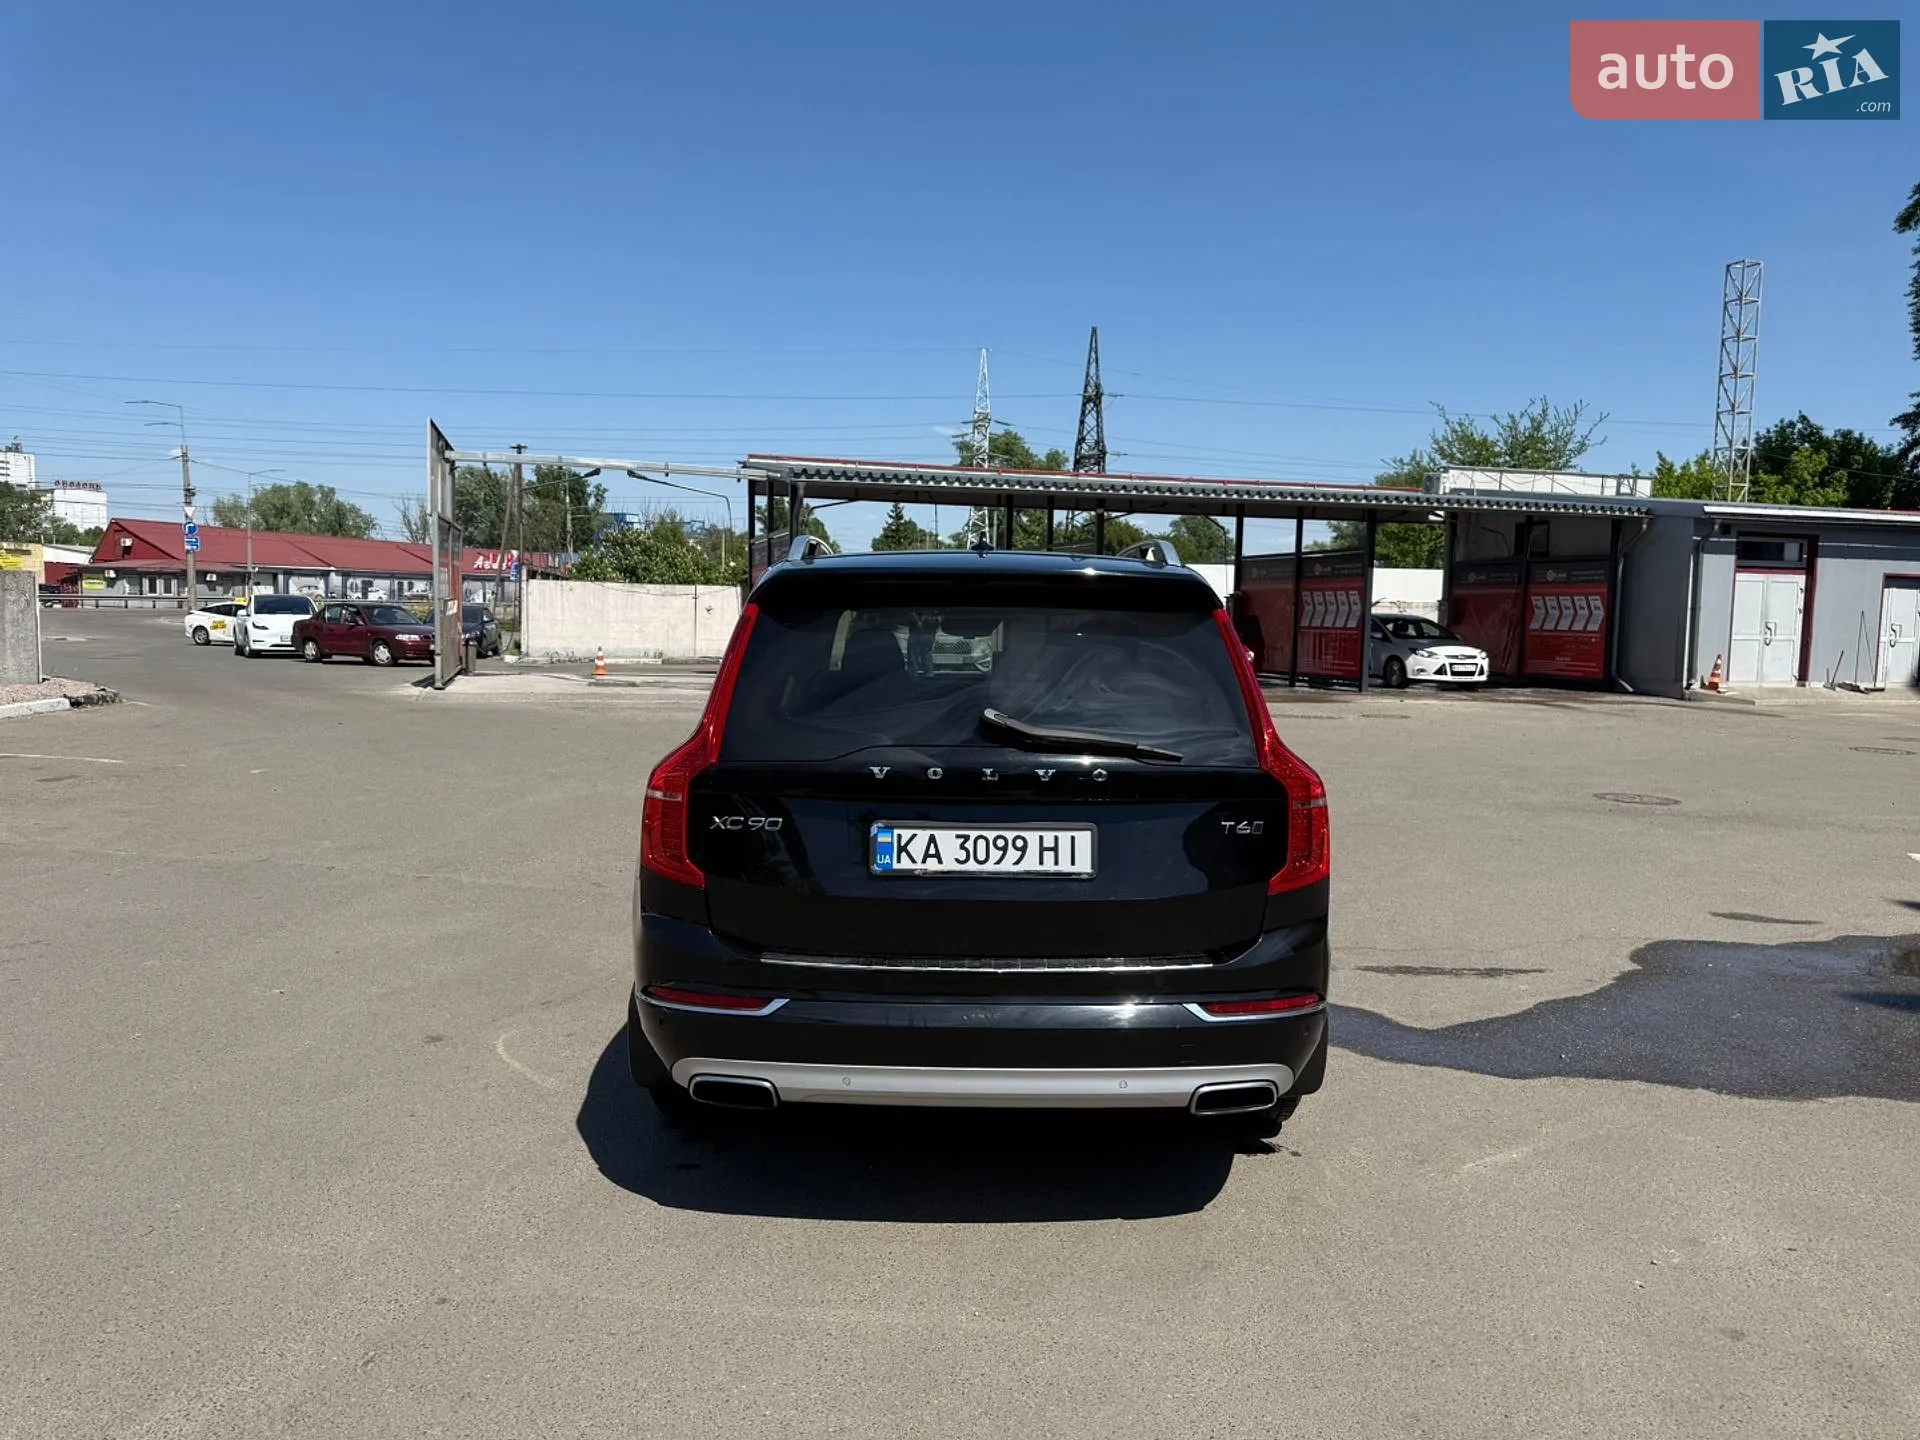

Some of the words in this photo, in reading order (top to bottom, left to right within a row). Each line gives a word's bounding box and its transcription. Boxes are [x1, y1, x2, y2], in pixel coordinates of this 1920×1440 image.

[869, 766, 1109, 782] VOLVO
[895, 833, 944, 865] KA
[954, 834, 1029, 866] 3099
[1038, 835, 1077, 867] HI
[877, 853, 892, 864] UA
